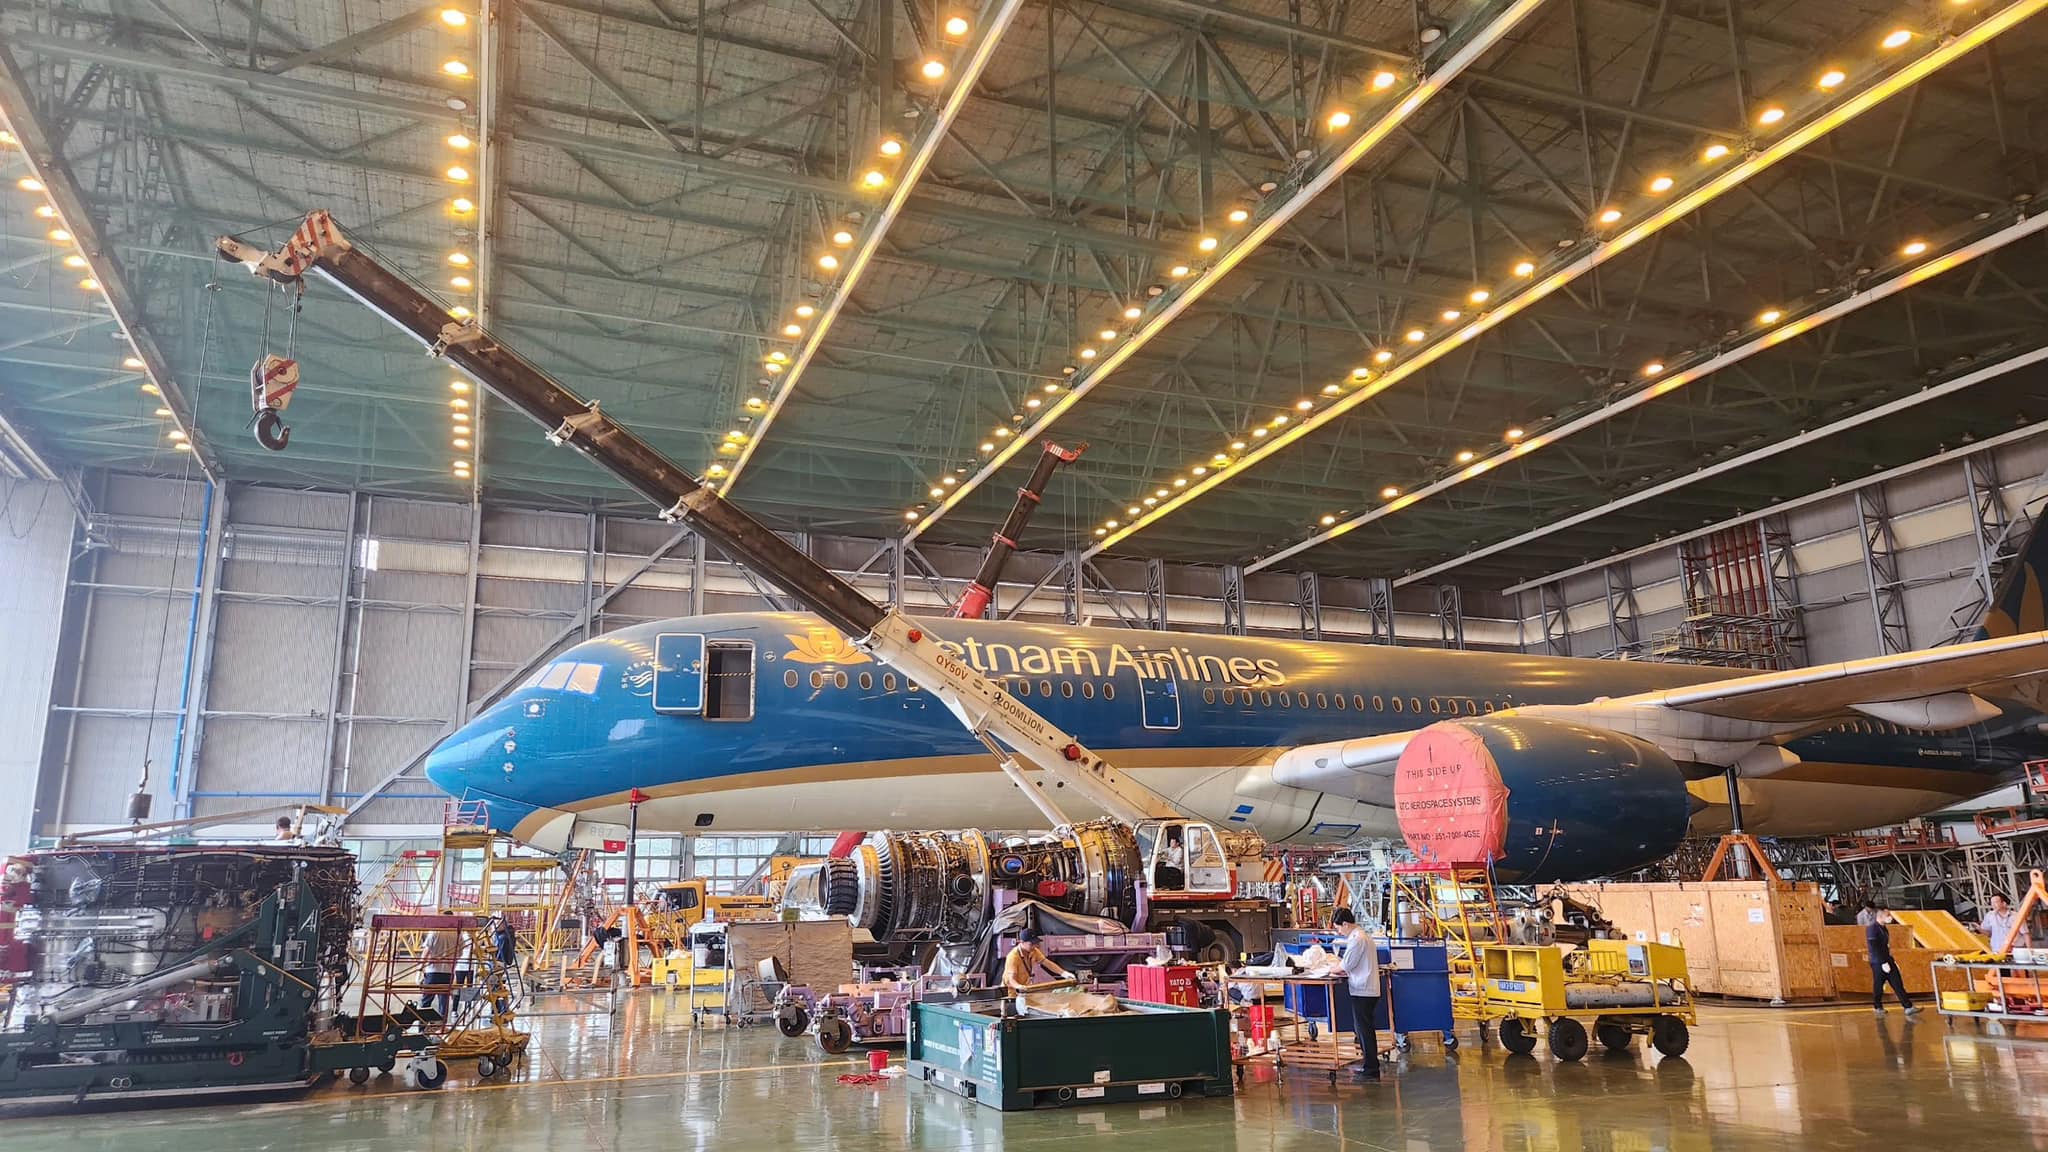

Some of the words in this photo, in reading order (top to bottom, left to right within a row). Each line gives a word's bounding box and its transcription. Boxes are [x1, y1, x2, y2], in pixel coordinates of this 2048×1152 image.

[936, 654, 969, 681] QY50V
[1107, 643, 1287, 687] Airlines
[1406, 769, 1424, 780] THIS
[1427, 766, 1447, 777] SIDE
[1449, 764, 1462, 774] UP
[1171, 991, 1188, 1006] T4
